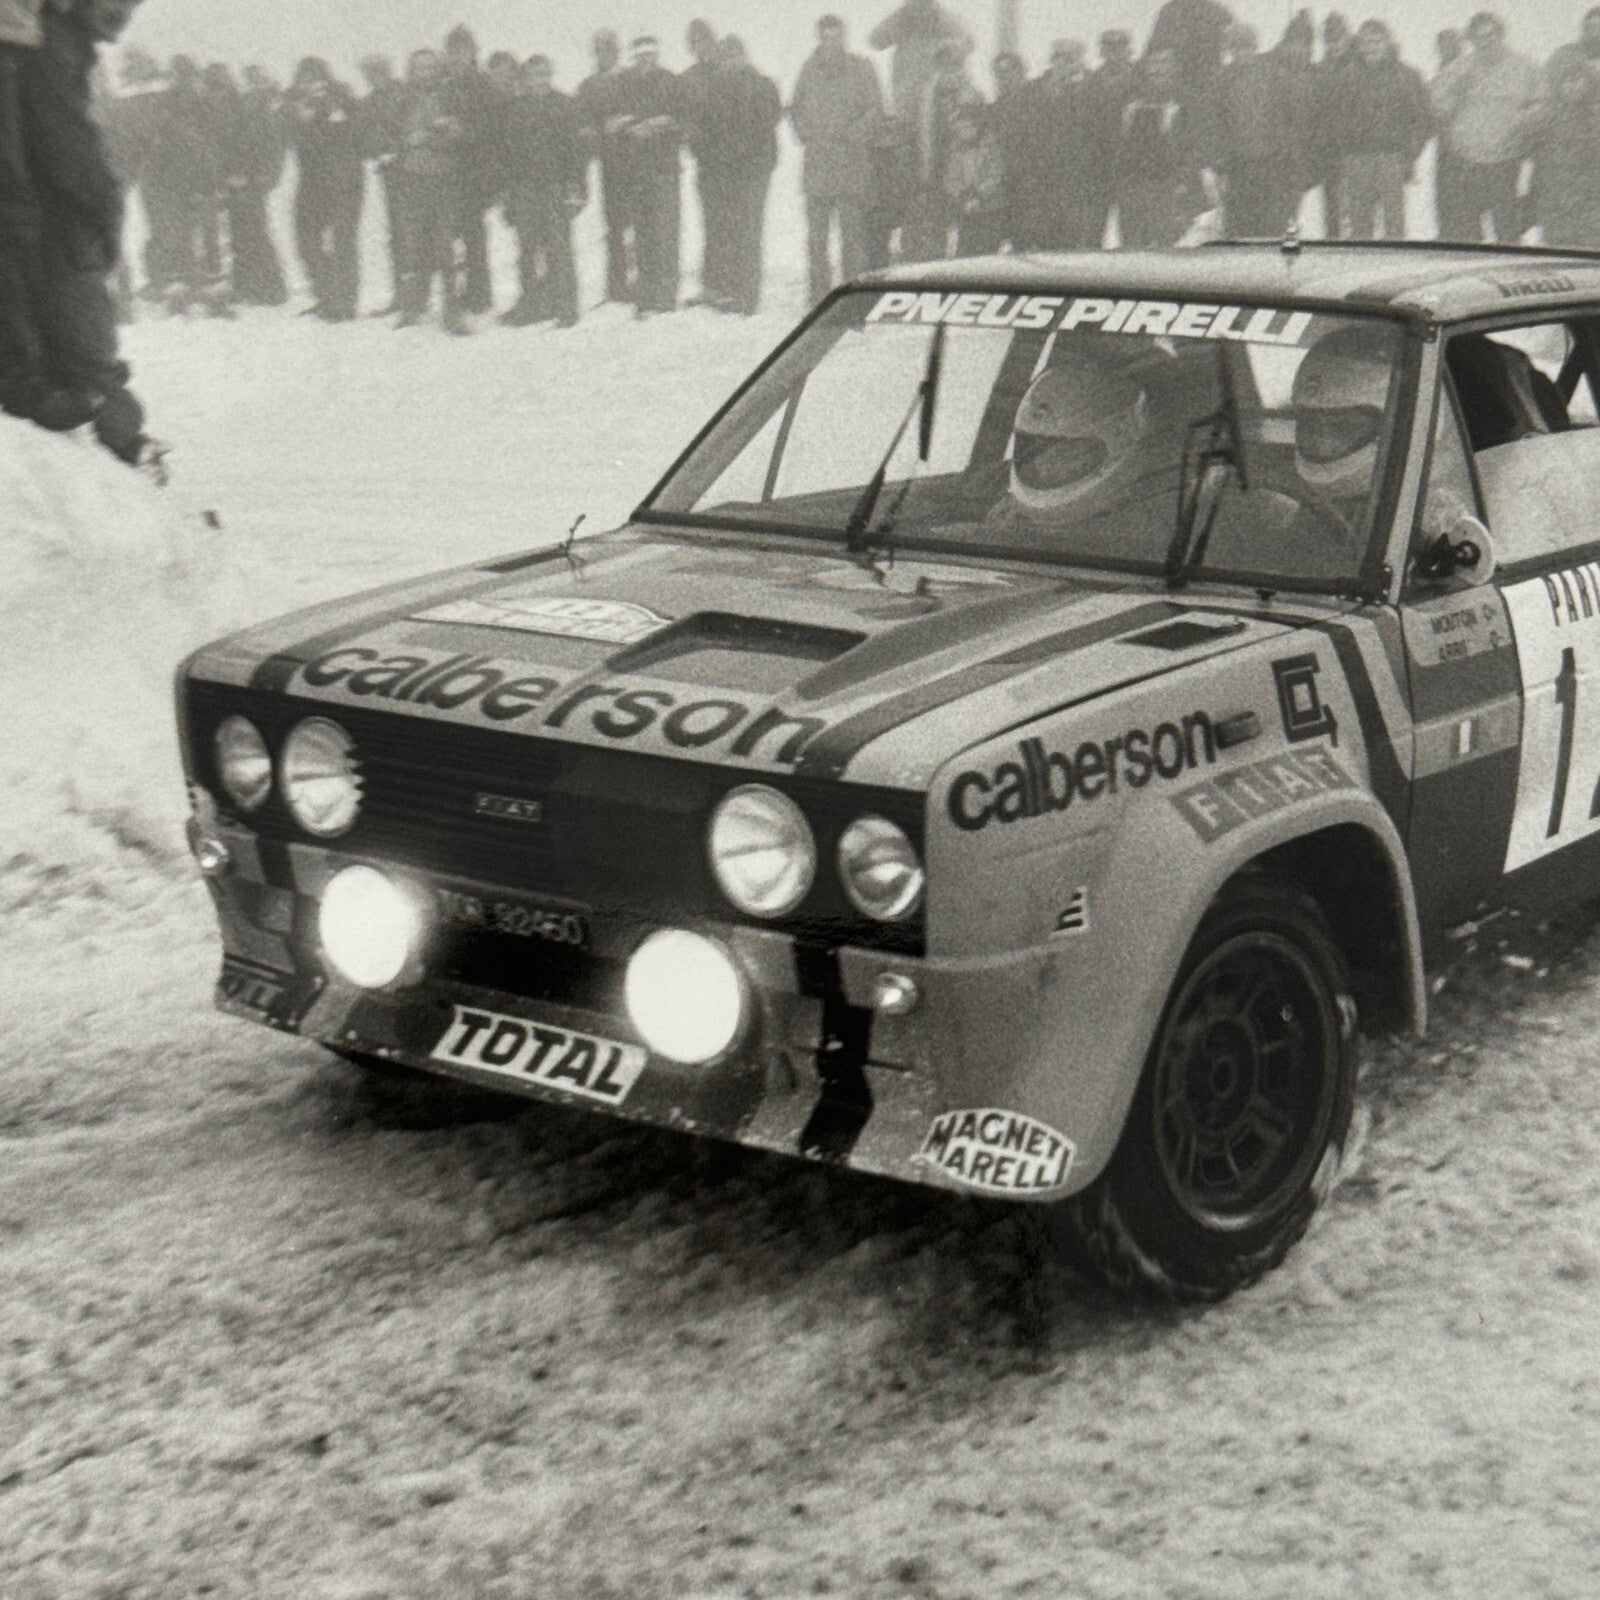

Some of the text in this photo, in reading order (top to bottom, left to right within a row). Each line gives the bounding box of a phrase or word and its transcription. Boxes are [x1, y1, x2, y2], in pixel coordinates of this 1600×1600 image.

[865, 292, 1313, 346] PNEUS PIRELLI
[1541, 563, 1600, 627] PARI
[303, 646, 828, 764] calberson
[1545, 646, 1600, 840] 1
[946, 709, 1217, 831] calberson
[1187, 752, 1341, 828] FIAT
[449, 1011, 625, 1097] TOTAL
